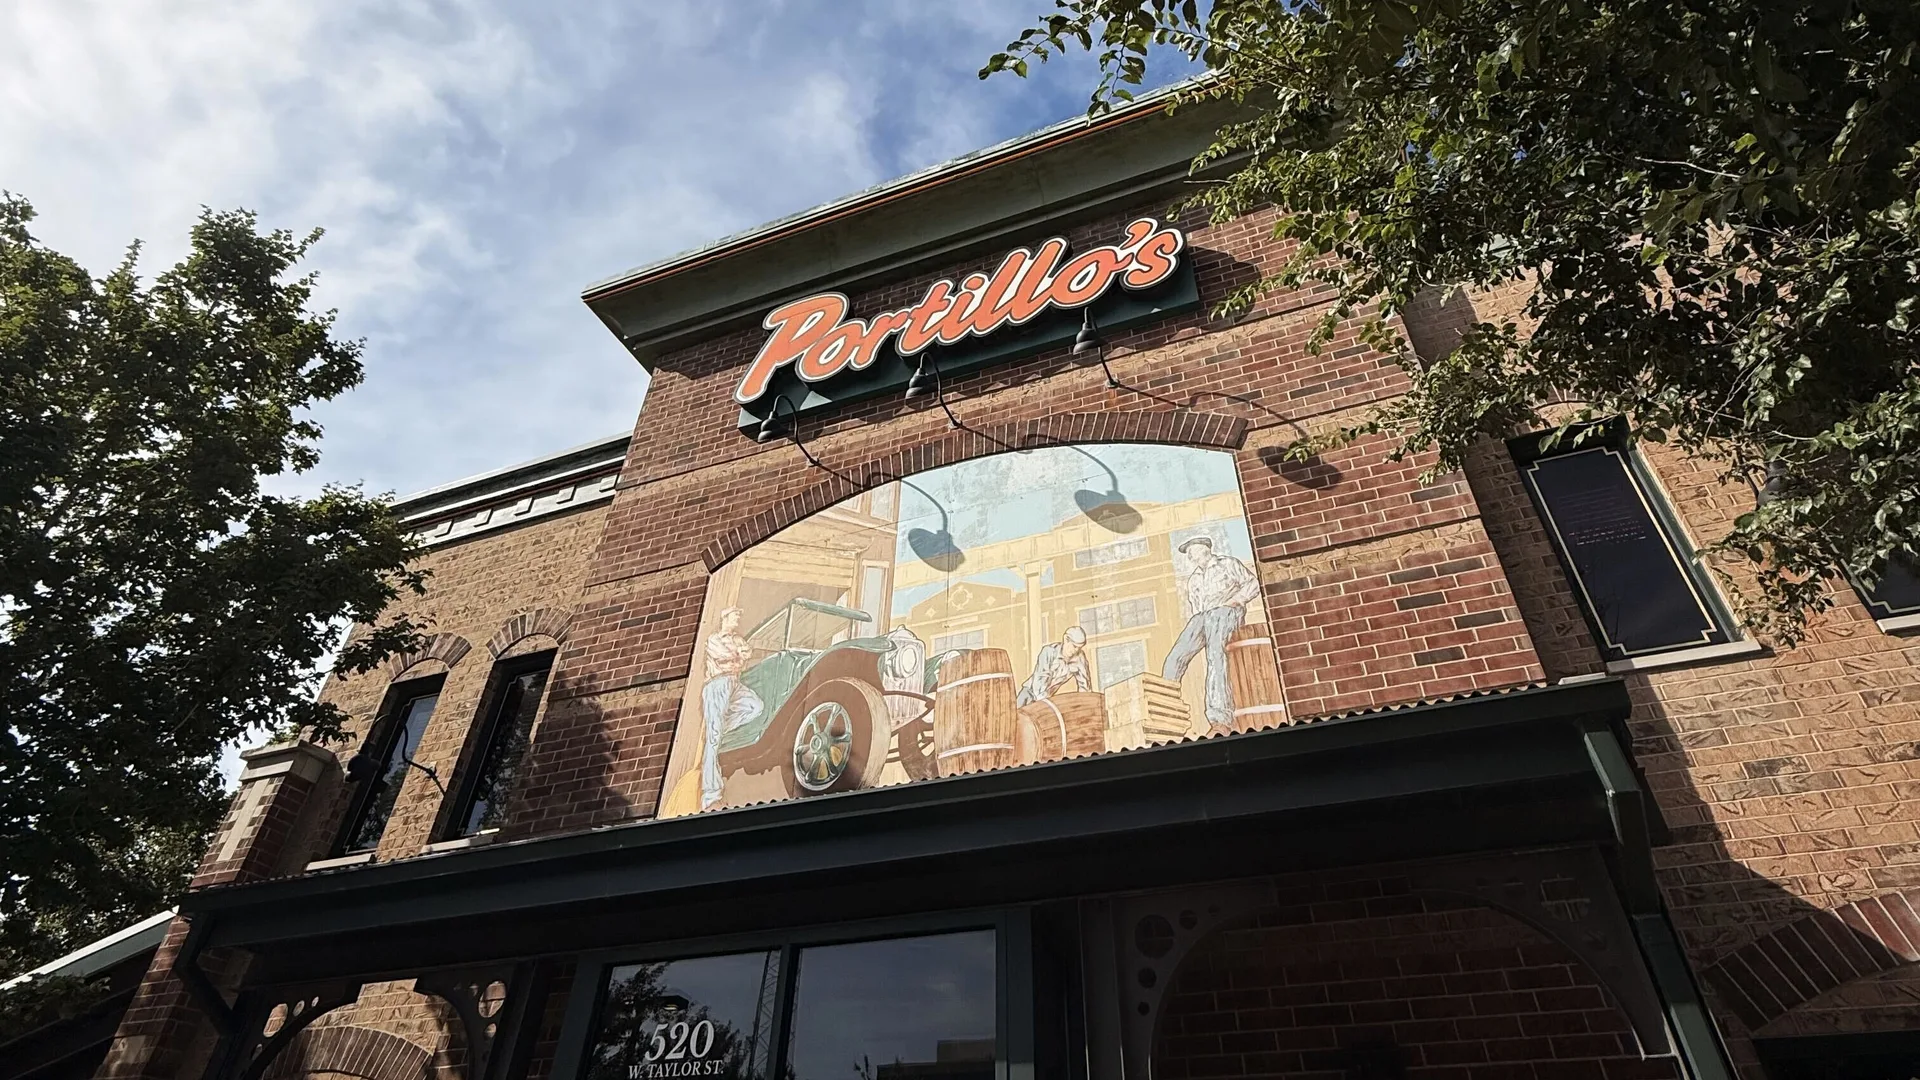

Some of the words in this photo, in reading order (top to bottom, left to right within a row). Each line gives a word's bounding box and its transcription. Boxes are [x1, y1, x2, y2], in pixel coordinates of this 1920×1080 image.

[733, 217, 1185, 404] Portillo's
[644, 1019, 715, 1061] 520
[628, 1064, 643, 1080] W.
[648, 1062, 701, 1078] TAYLOR
[703, 1059, 724, 1076] ST.
